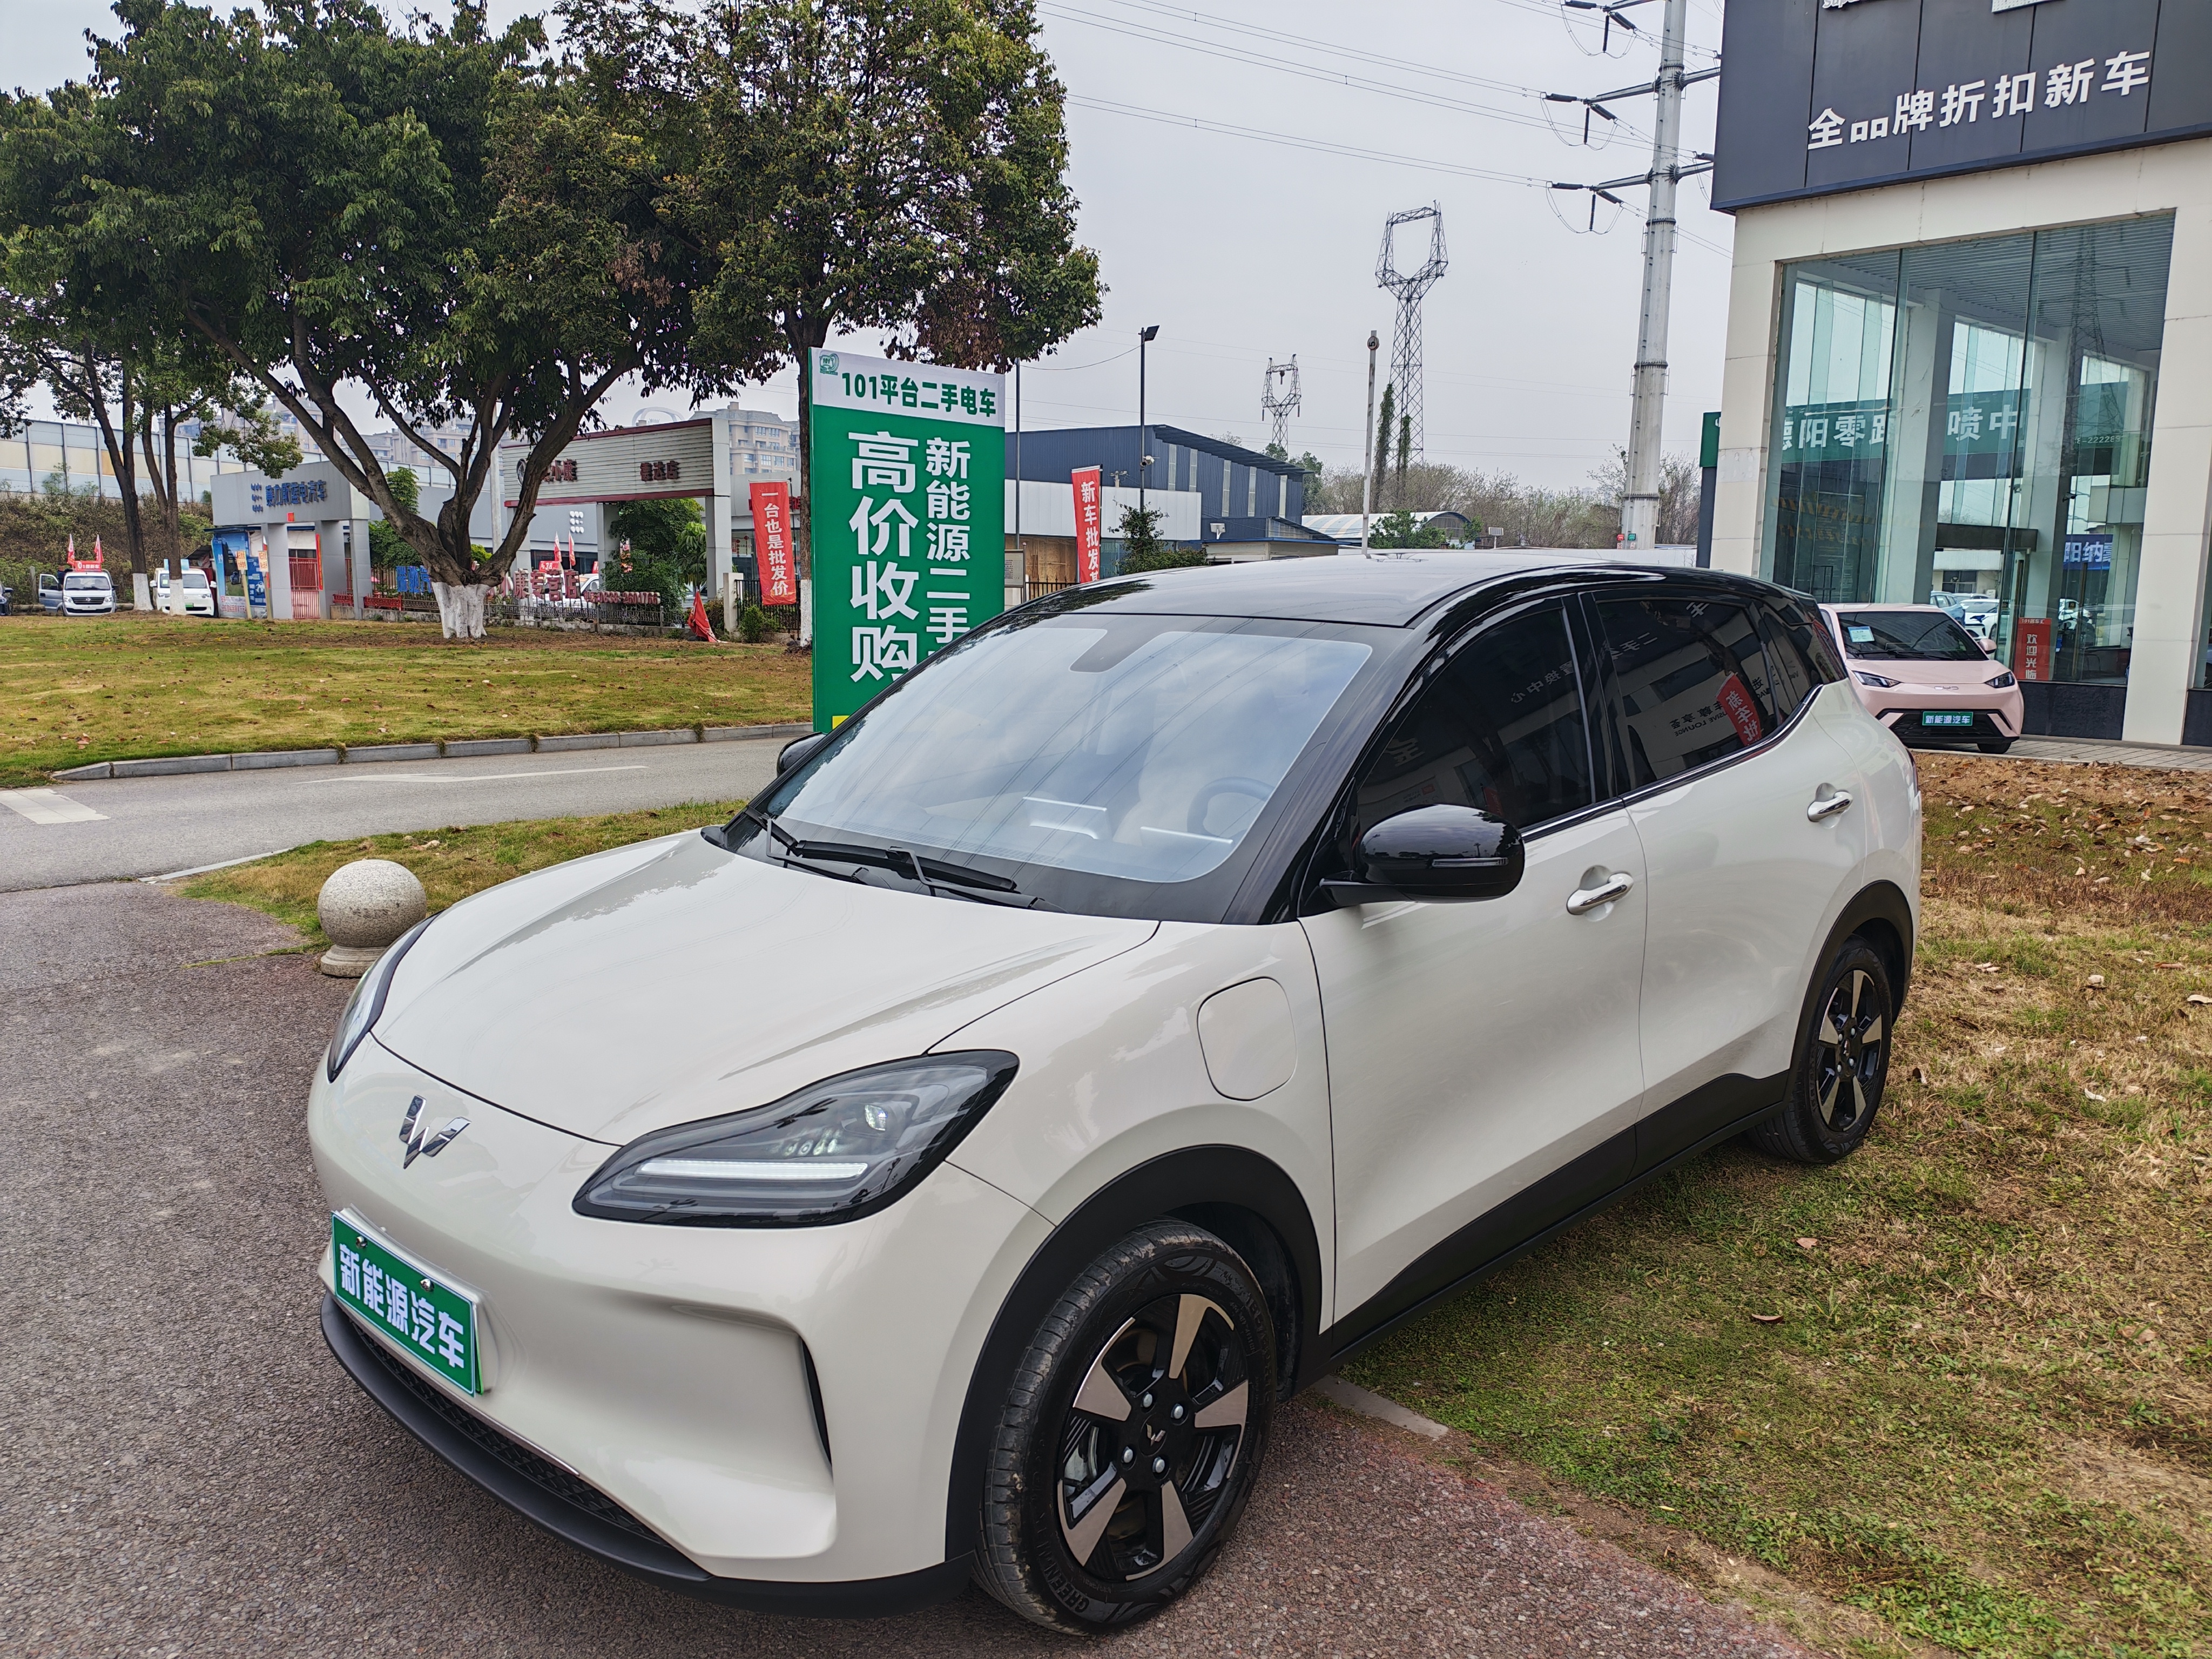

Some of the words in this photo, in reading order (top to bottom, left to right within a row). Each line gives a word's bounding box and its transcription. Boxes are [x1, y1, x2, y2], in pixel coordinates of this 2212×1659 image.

[1808, 51, 2151, 150] 全品牌折扣新车
[841, 372, 997, 418] 101平台二手电车
[761, 492, 789, 596] 一台也是批发价
[848, 431, 919, 683] 高价收购
[926, 437, 971, 653] 新能源二手
[2025, 633, 2038, 679] 欢迎光临
[1925, 714, 1971, 724] 新能源汽车
[339, 1243, 465, 1368] 新能源汽车
